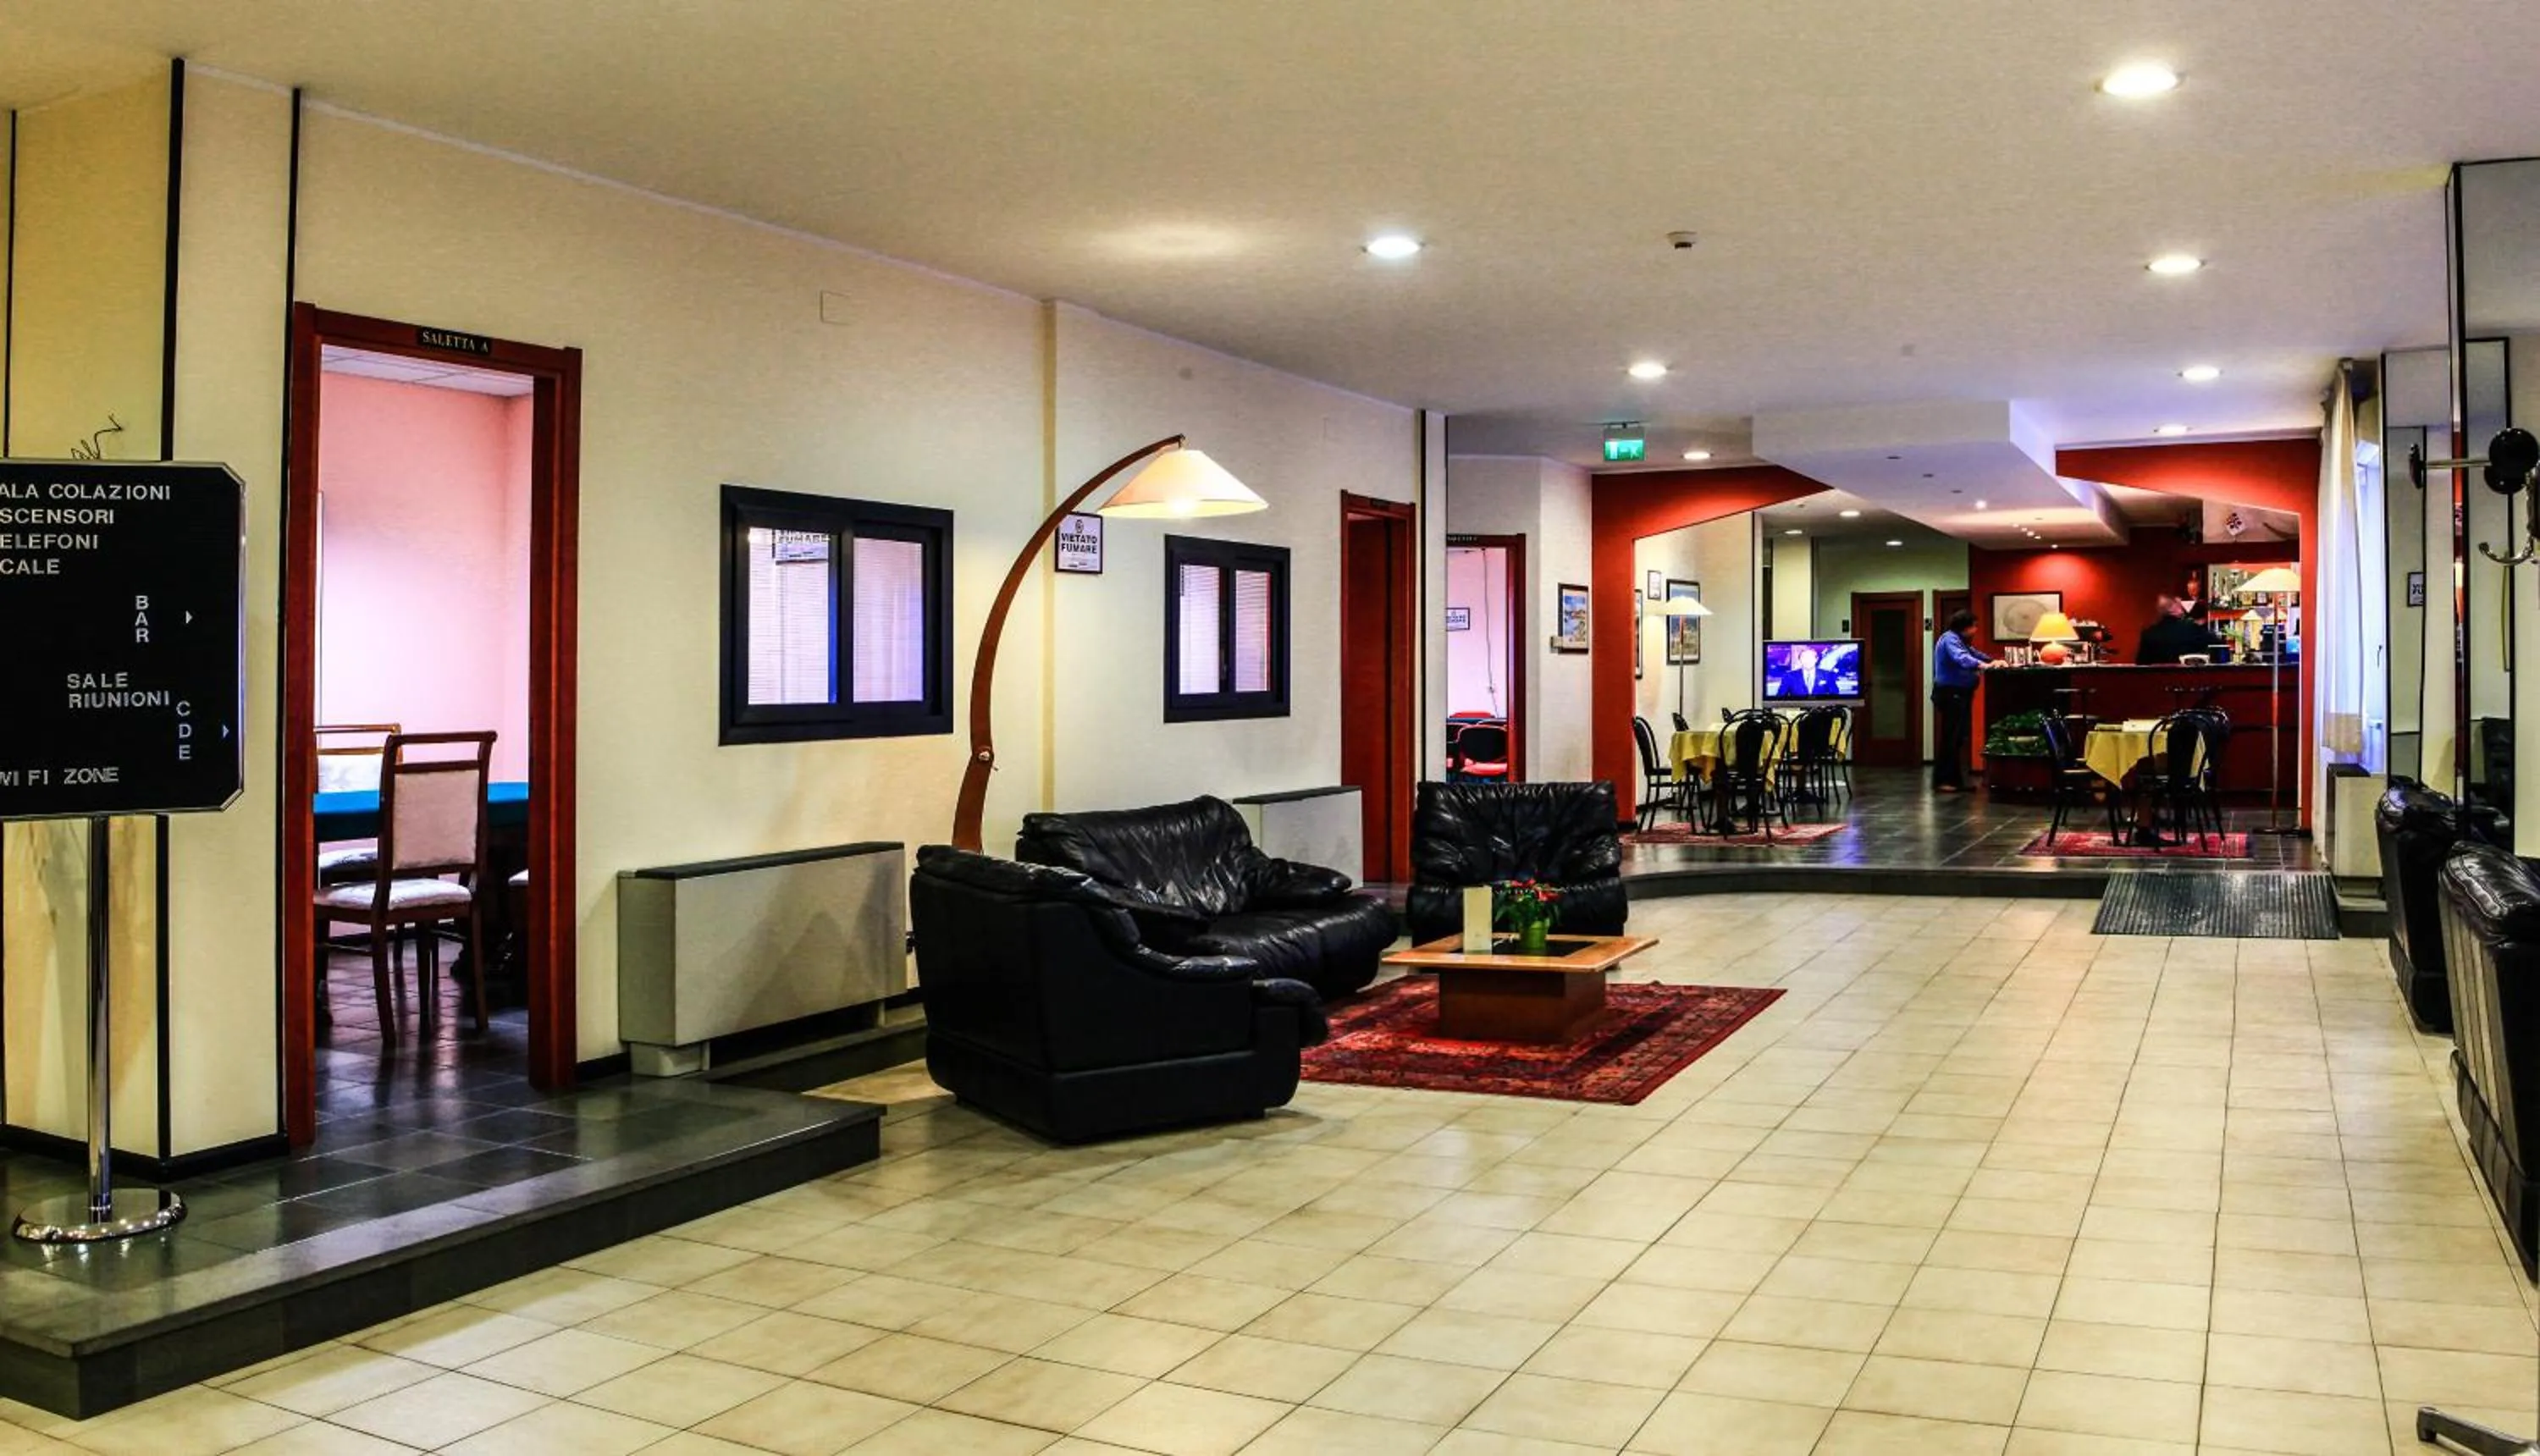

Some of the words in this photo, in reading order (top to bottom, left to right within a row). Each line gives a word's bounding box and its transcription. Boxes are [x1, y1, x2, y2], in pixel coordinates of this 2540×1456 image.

[422, 331, 475, 350] SALETTA
[48, 483, 170, 500] COLAZIONI
[0, 508, 114, 524] SCENSORI
[0, 533, 98, 549] ELEFONI
[1061, 532, 1098, 544] VIETATO
[1061, 543, 1098, 554] FUMARE
[0, 558, 60, 575] CALE
[135, 595, 149, 643] BAR
[67, 672, 128, 689] SALE
[68, 690, 169, 709] RIUNIONI
[28, 769, 48, 786] FI
[64, 767, 119, 785] ZONE
